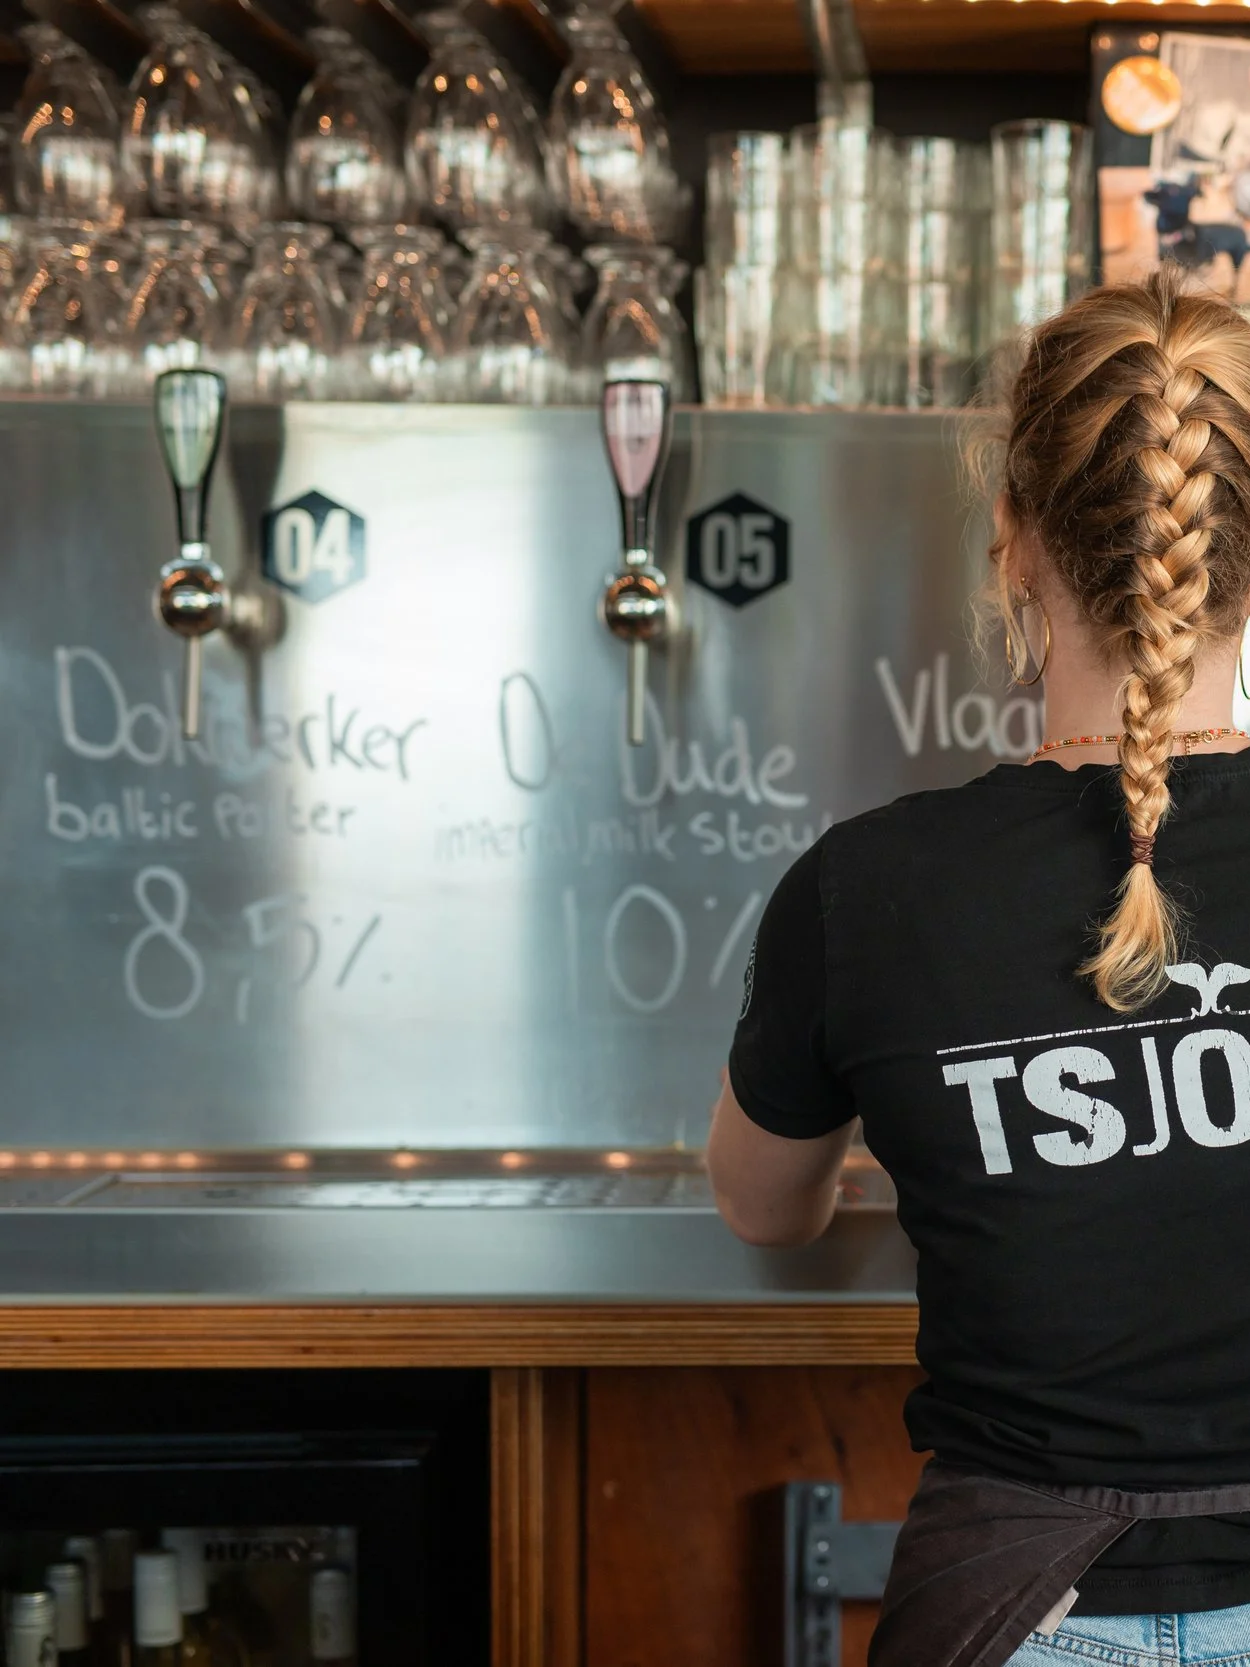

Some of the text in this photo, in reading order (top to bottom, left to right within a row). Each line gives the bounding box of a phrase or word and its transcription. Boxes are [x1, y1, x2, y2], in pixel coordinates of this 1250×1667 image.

[274, 506, 354, 588] 04
[701, 511, 776, 590] 05
[614, 684, 809, 809] Dude
[44, 771, 198, 844] baltic
